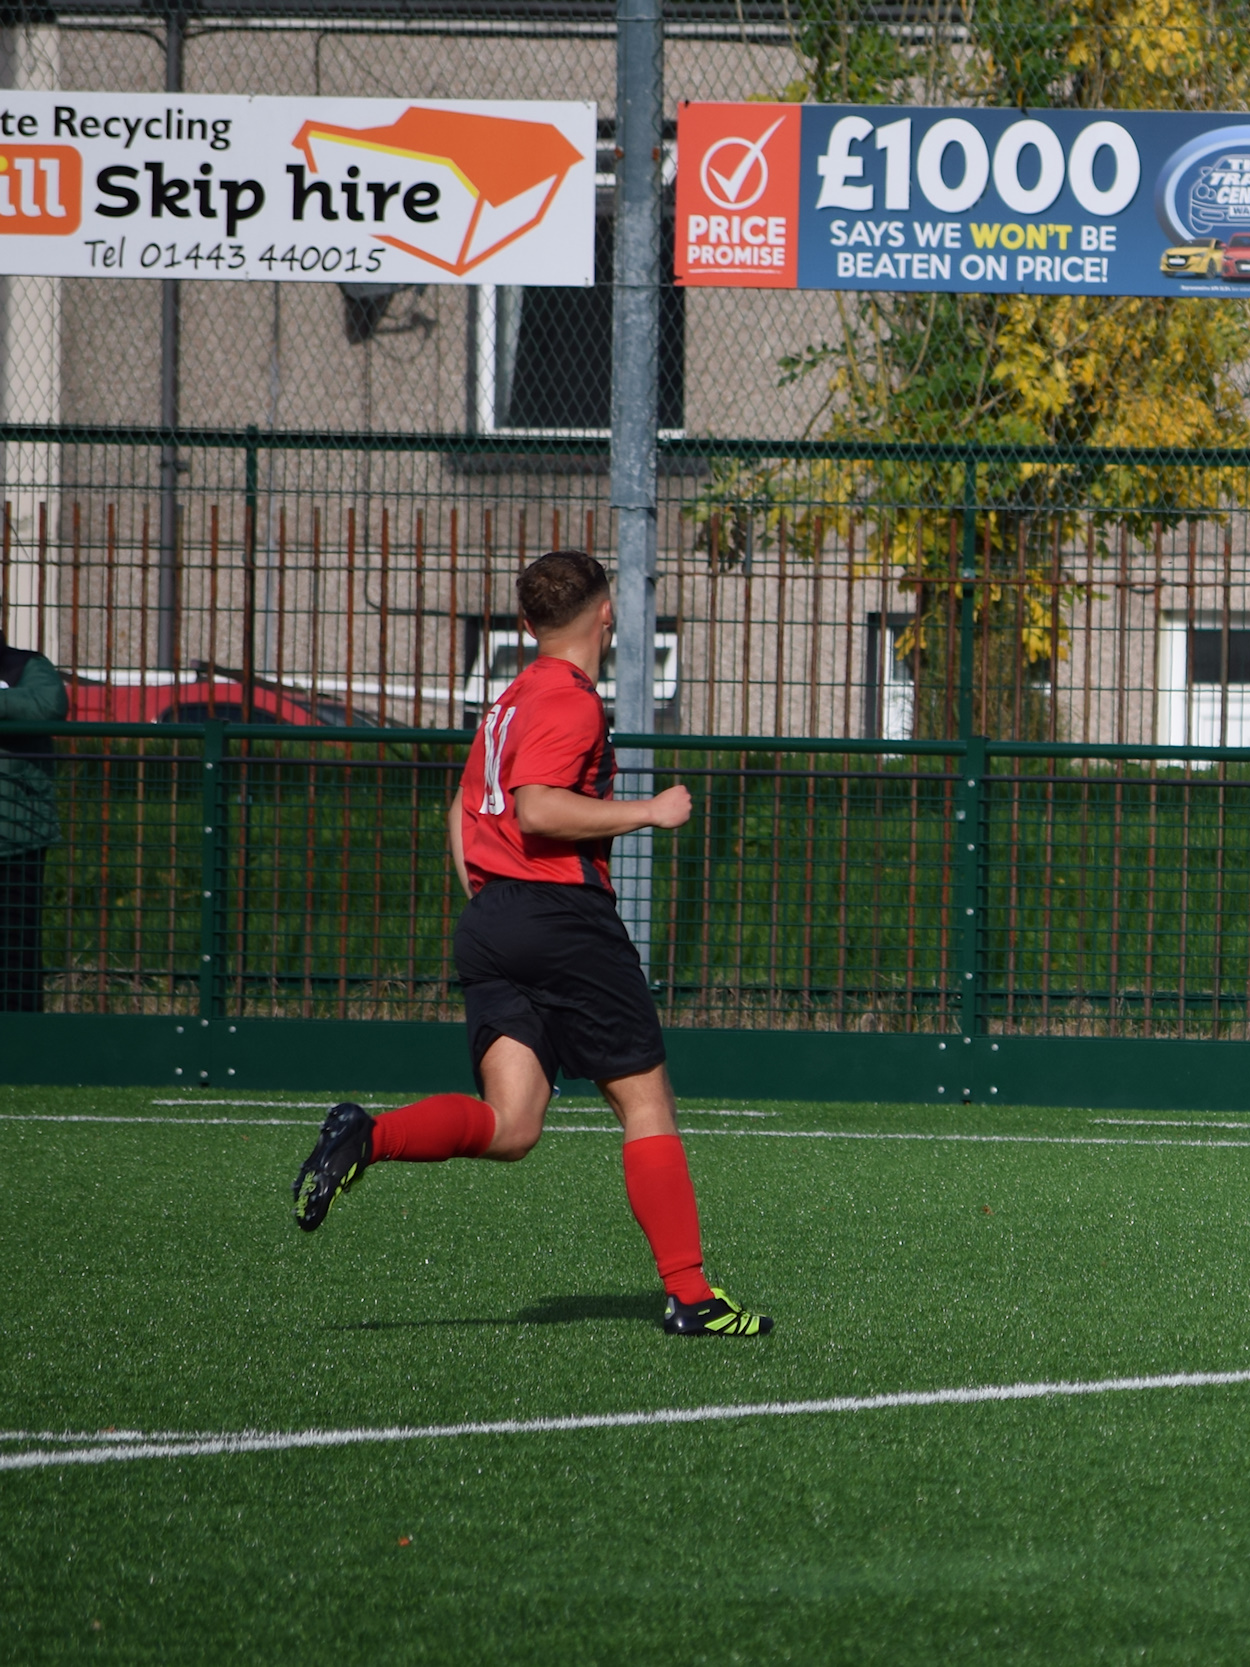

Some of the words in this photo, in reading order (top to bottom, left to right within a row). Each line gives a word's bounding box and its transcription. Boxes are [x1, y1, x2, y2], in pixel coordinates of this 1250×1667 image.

[54, 106, 232, 151] Recycling
[816, 116, 1141, 216] £1000
[94, 162, 265, 237] Skip
[286, 164, 440, 223] hire
[688, 215, 786, 245] PRICE
[830, 220, 905, 247] SAYS
[913, 222, 961, 248] WE
[970, 223, 1072, 250] WON'T
[1081, 226, 1117, 251] BE
[84, 236, 125, 268] Tel
[140, 242, 245, 270] 01443
[259, 244, 386, 272] 440015
[687, 245, 786, 266] PROMISE
[837, 252, 951, 279] BEATEN
[960, 254, 1007, 281] ON
[1016, 255, 1109, 283] PRICE!
